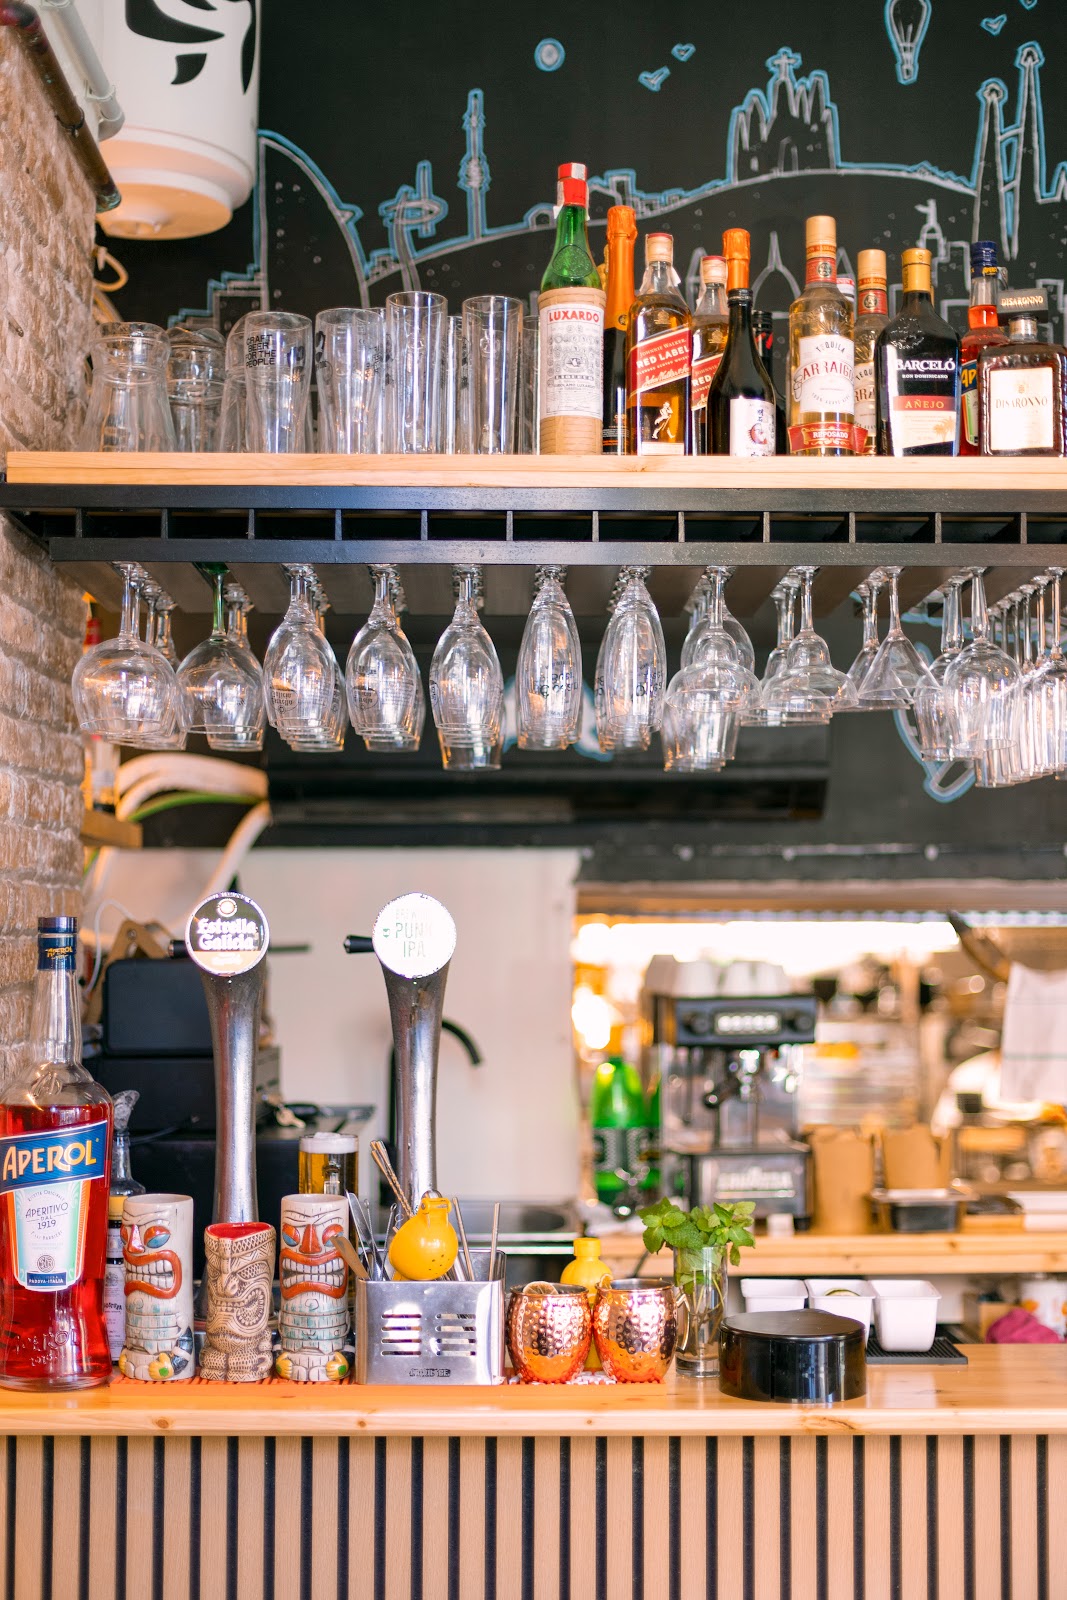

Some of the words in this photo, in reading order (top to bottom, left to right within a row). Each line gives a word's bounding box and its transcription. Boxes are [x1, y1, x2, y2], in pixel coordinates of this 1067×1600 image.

[1001, 295, 1044, 306] DISARONNO
[549, 310, 600, 322] LUXARDO
[247, 334, 272, 346] CRAFT
[248, 342, 269, 352] BEER
[640, 345, 662, 358] JOHNNIE
[816, 341, 846, 353] TEQUILA
[259, 350, 276, 358] THE
[637, 356, 656, 368] RED
[658, 346, 689, 360] LABEL
[246, 358, 275, 368] PEOPLE
[896, 358, 956, 372] BARCELÓ
[692, 375, 711, 386] RED
[856, 368, 873, 381] TEQU
[905, 399, 944, 408] AÑEJO
[995, 396, 1048, 408] DISARONNO
[812, 430, 849, 439] REPOSADO
[197, 918, 258, 934] Estrella
[199, 934, 254, 950] Galicia
[47, 946, 73, 957] APEROL
[403, 941, 426, 958] IPA
[2, 1140, 97, 1180] APEROL
[25, 1202, 68, 1218] APERITIVO
[38, 1220, 56, 1230] 1919
